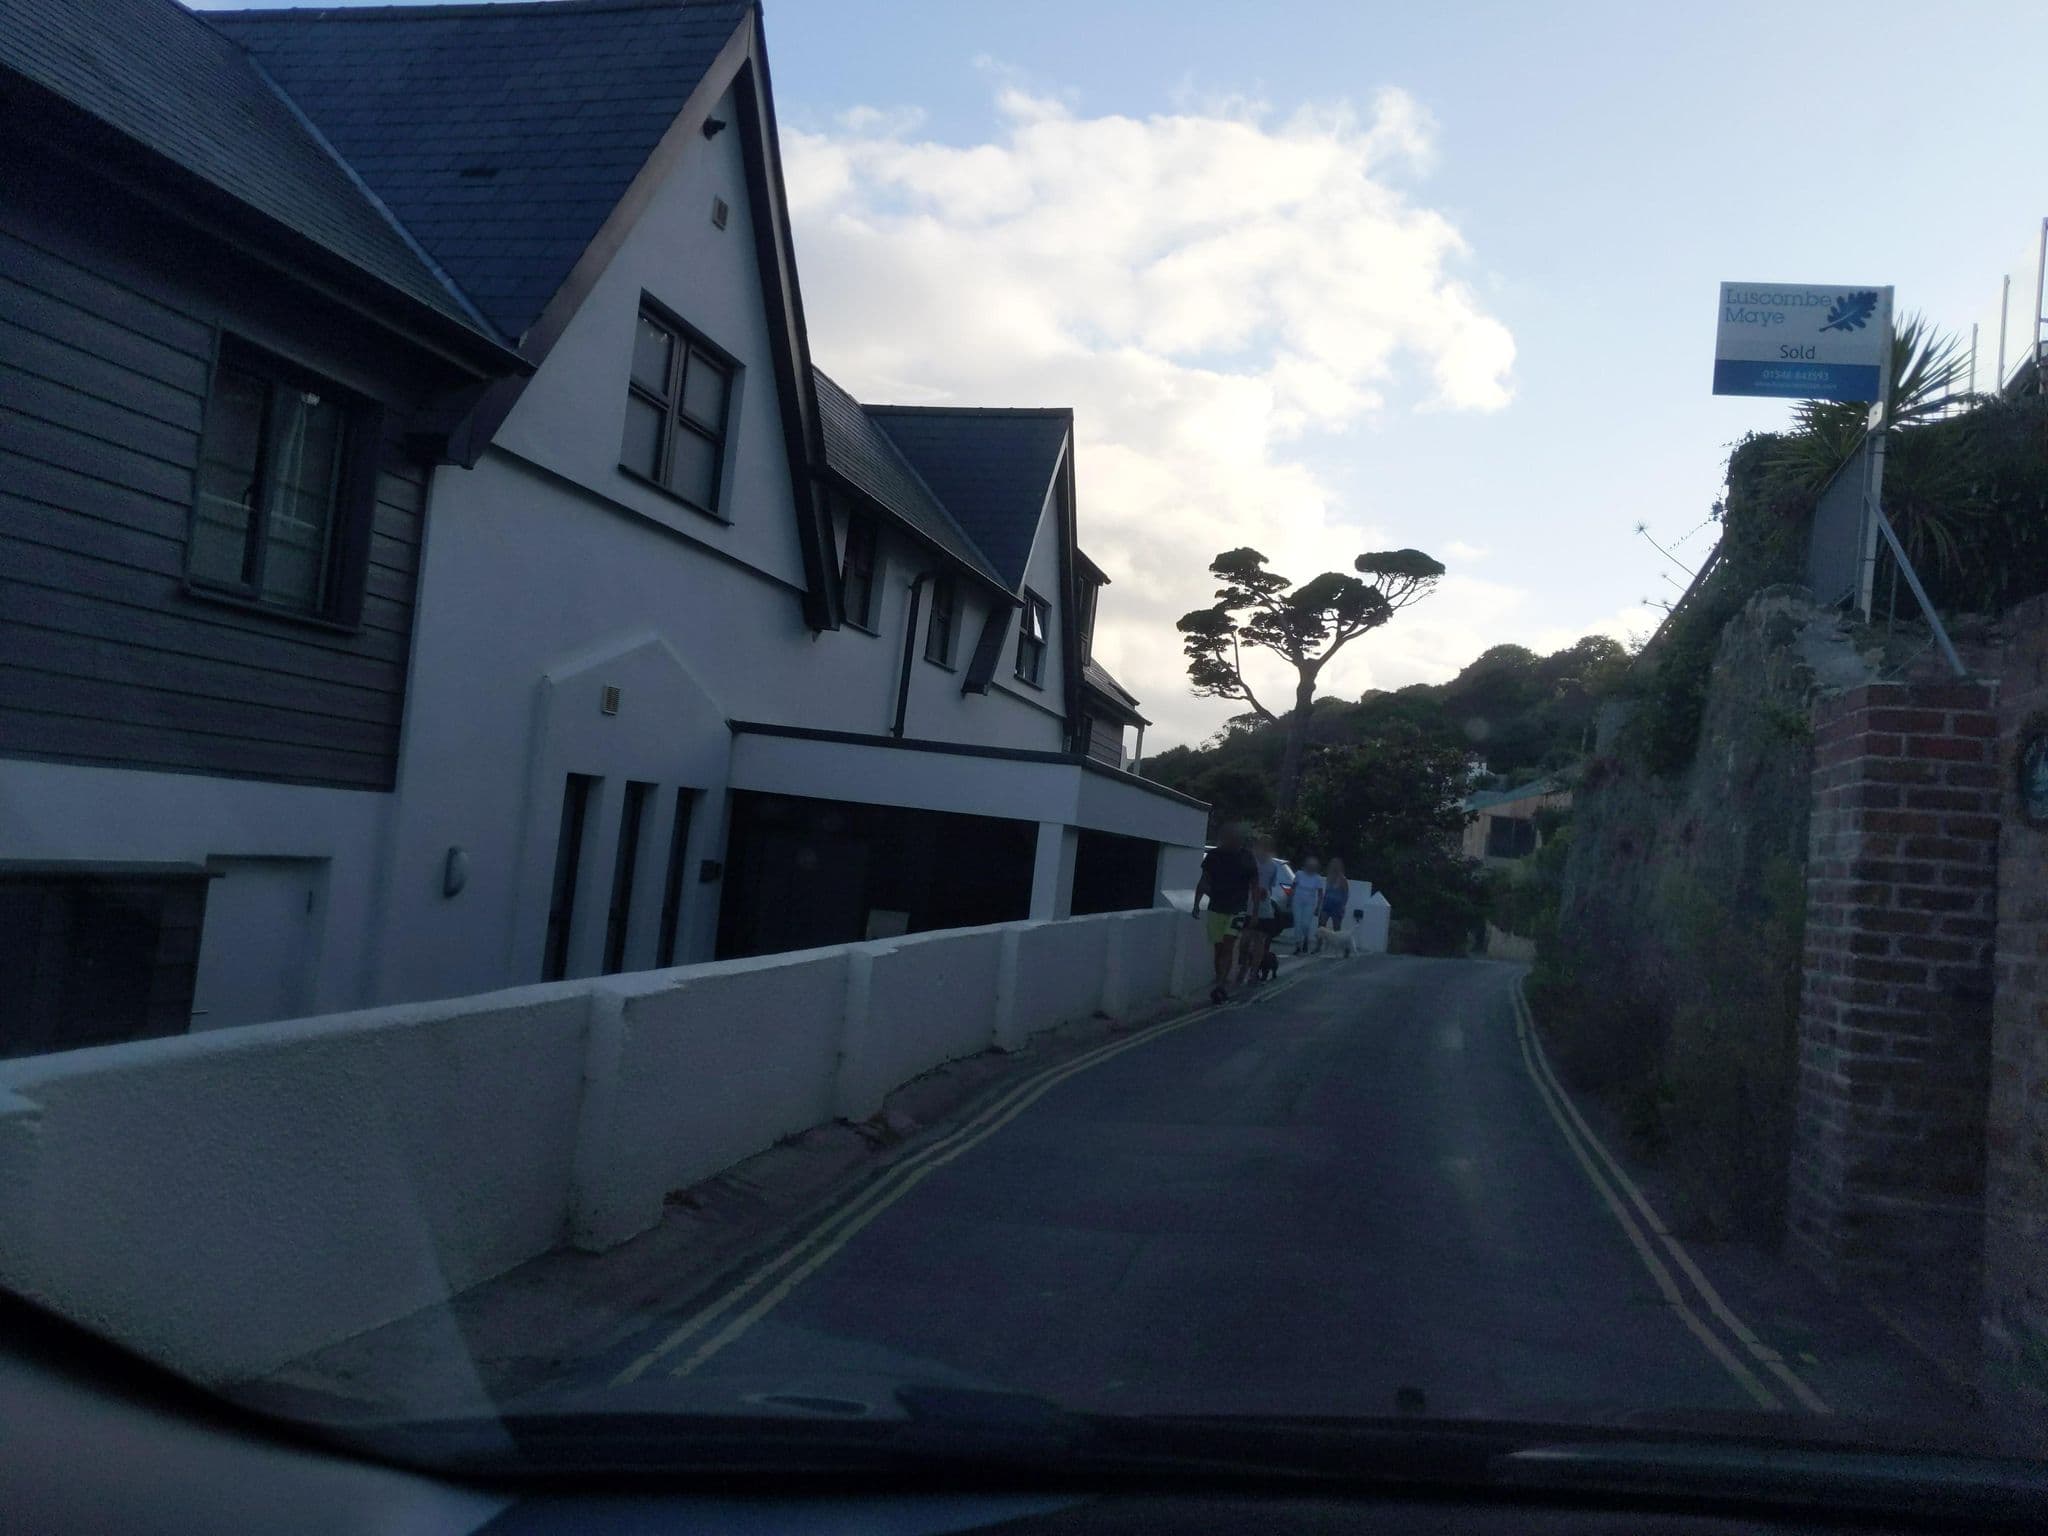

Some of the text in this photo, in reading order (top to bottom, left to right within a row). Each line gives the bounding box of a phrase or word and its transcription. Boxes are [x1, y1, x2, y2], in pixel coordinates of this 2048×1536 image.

[1726, 289, 1833, 306] Luscombe
[1726, 308, 1785, 328] Maye
[1780, 345, 1817, 360] Sold
